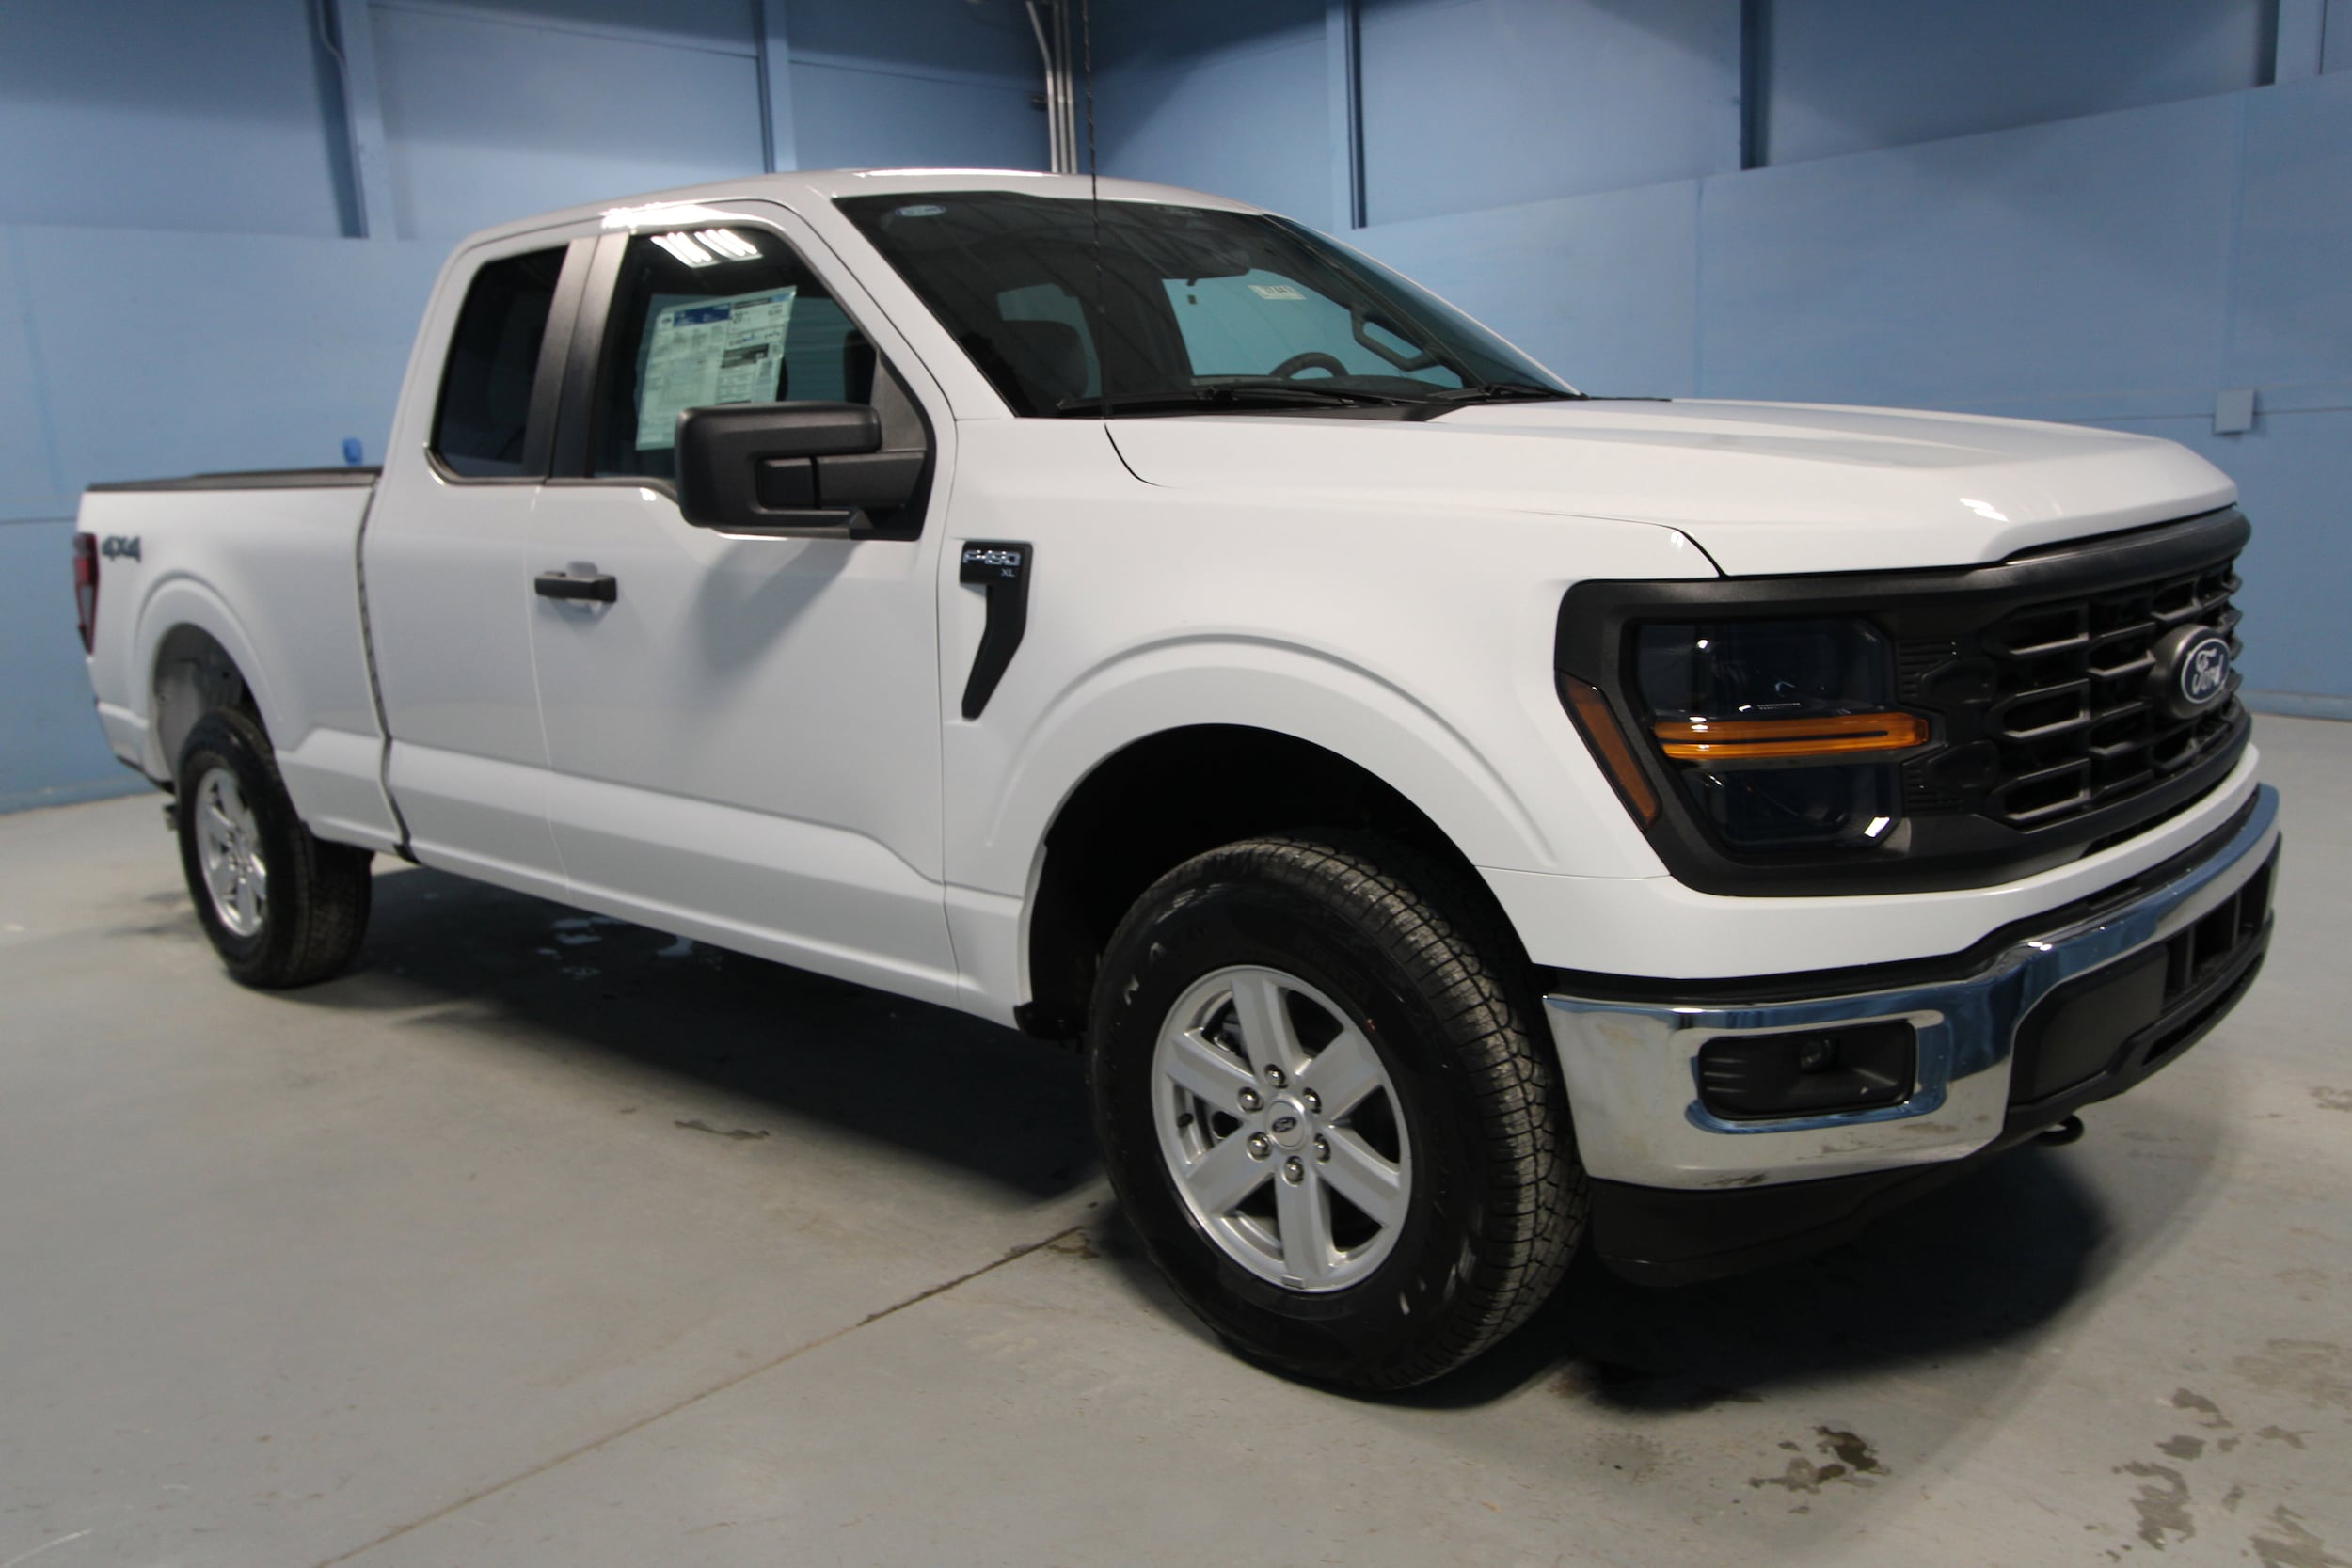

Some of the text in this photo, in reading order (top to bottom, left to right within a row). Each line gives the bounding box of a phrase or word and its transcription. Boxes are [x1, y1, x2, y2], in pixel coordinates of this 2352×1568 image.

[962, 549, 1021, 566] F-150
[1001, 568, 1015, 577] XL
[2190, 645, 2225, 696] Ford
